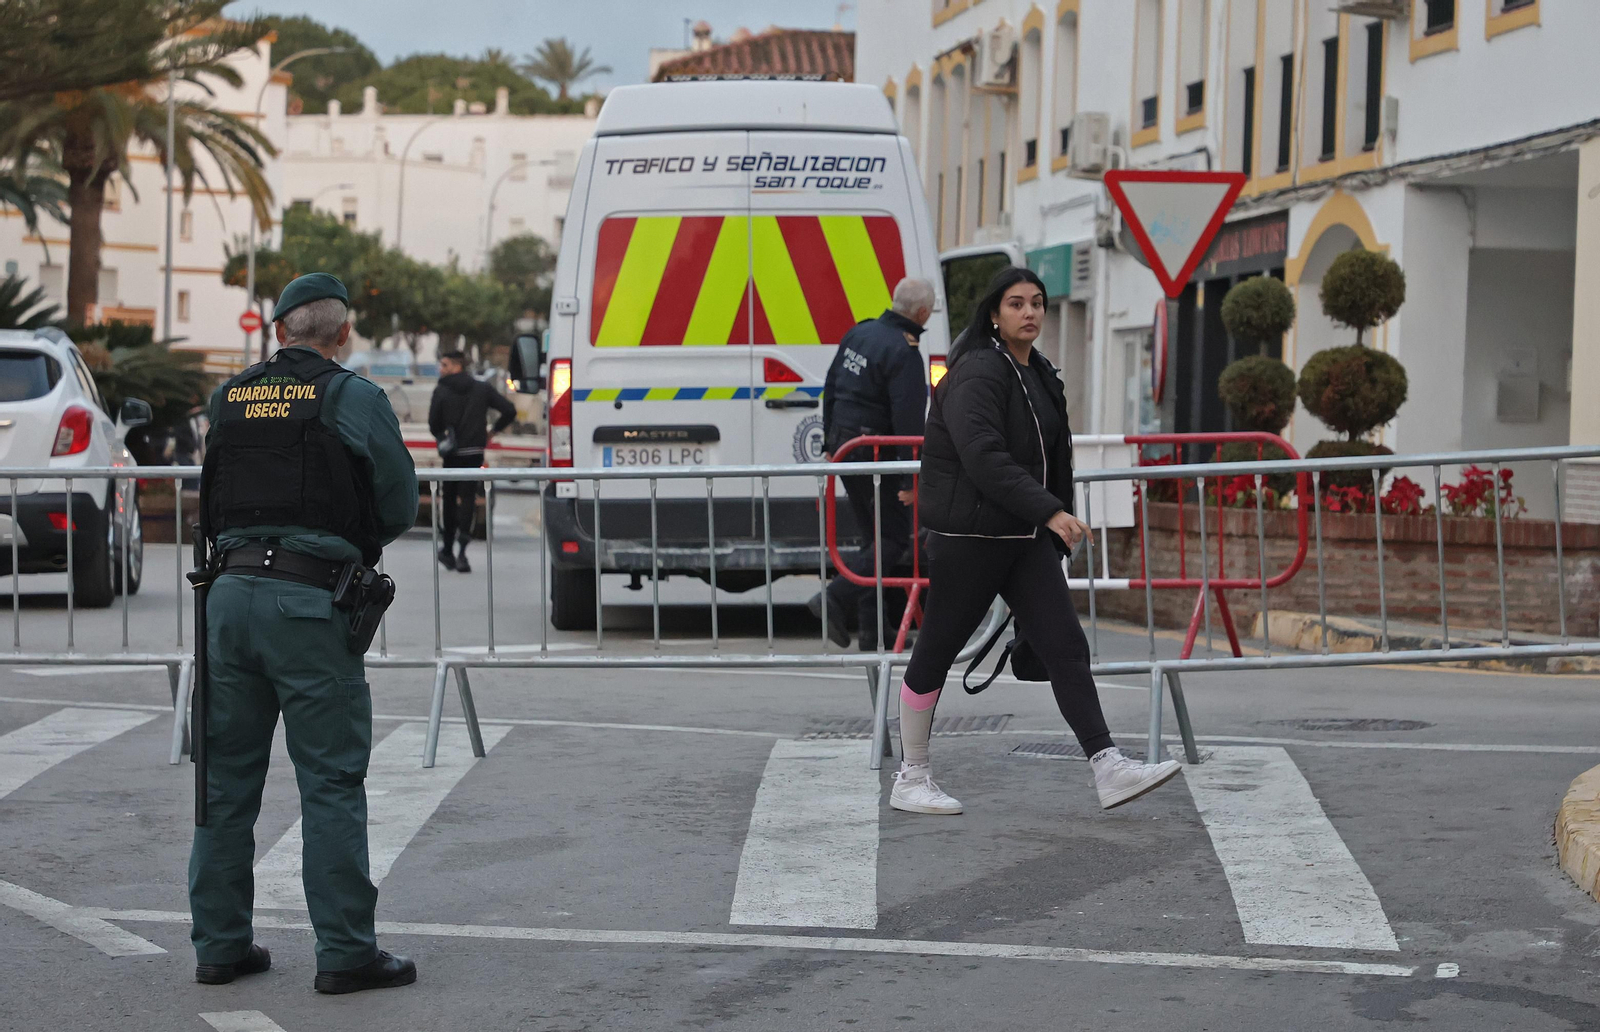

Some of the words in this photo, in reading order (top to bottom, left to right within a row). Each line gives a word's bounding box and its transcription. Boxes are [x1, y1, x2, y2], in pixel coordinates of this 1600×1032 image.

[227, 385, 281, 402] GUARDIA
[283, 384, 317, 400] CIVIL
[244, 402, 291, 419] USECIC
[623, 430, 689, 438] MASTER
[615, 448, 662, 465] 5306
[668, 448, 703, 465] LPC
